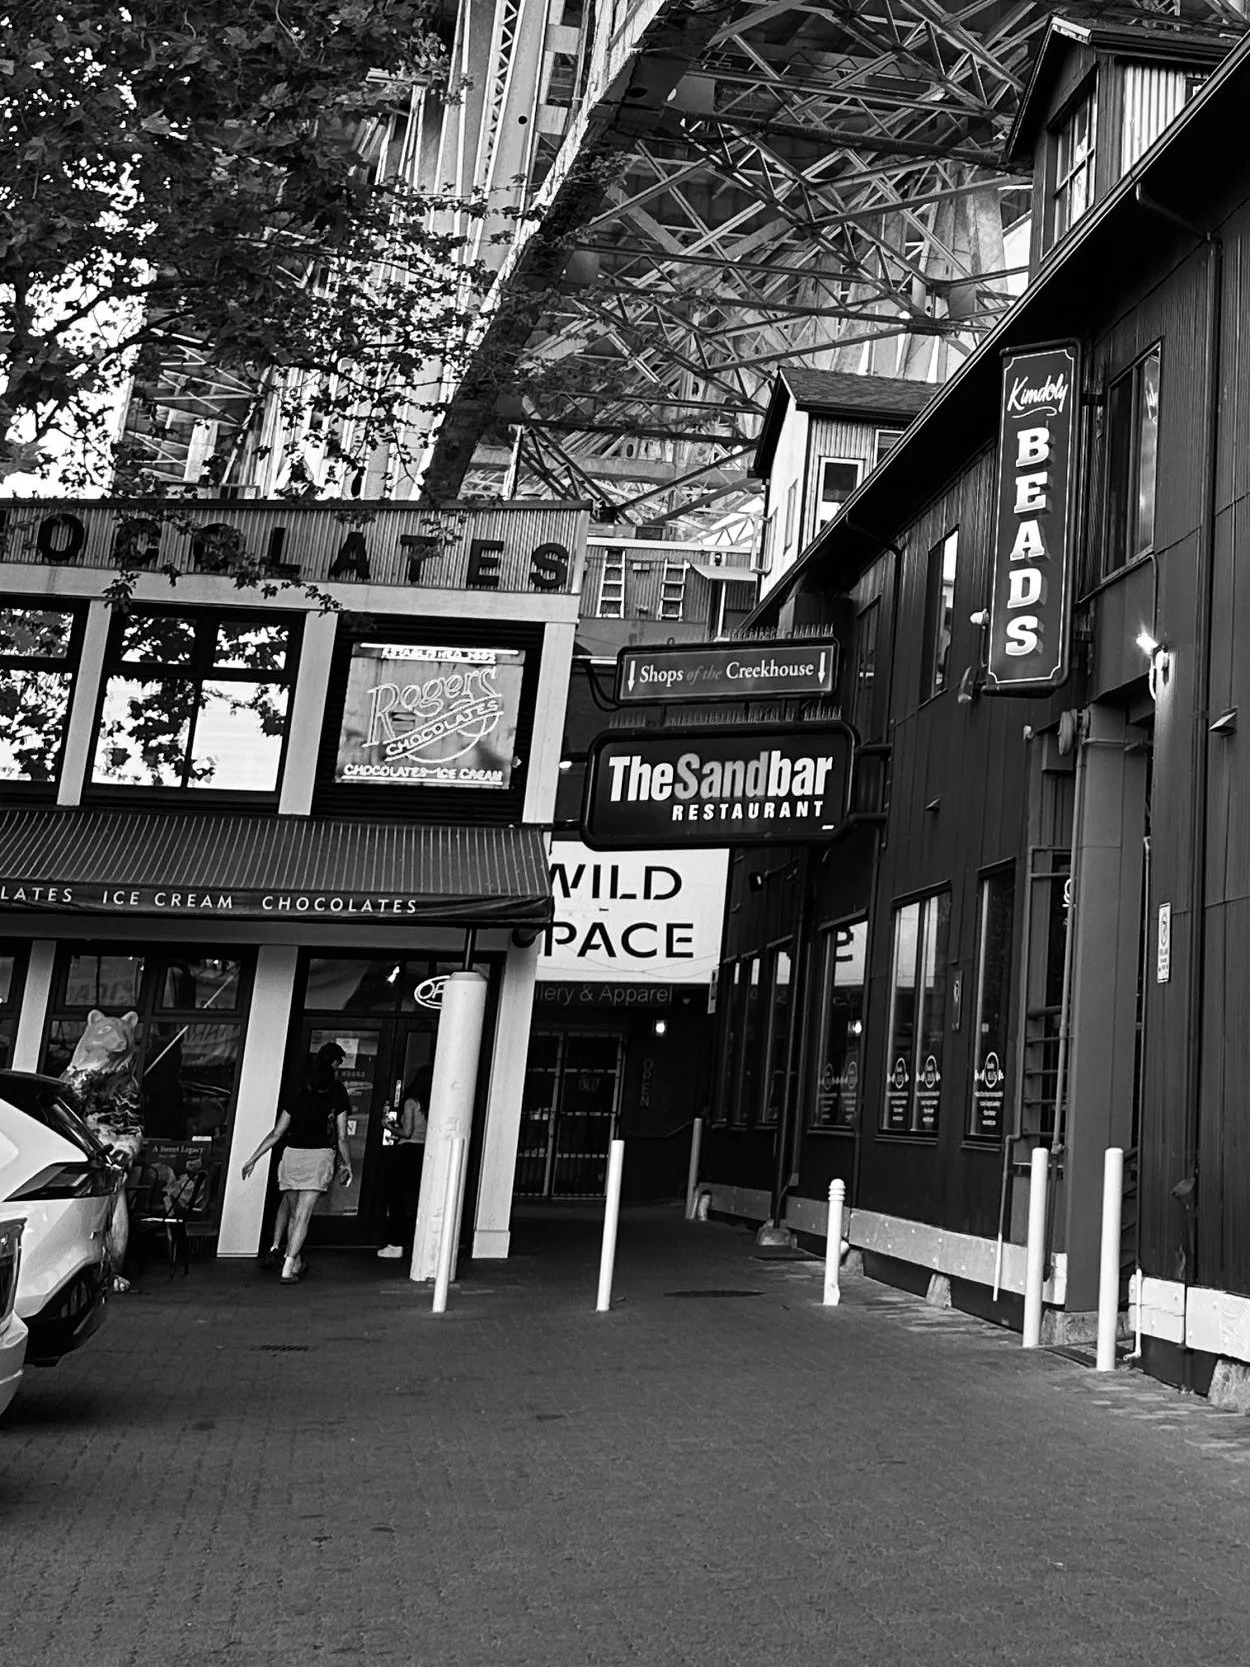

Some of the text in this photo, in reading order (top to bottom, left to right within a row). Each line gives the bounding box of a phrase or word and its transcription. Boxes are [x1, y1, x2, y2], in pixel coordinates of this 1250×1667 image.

[1007, 373, 1069, 413] Kimdoly
[0, 511, 569, 590] OCOLATES
[1005, 426, 1052, 657] BEADS
[639, 659, 814, 687] Shops of the Creekhouse
[386, 700, 498, 755] CHOCOLATES
[672, 800, 824, 821] RESTAURANT
[0, 886, 417, 914] LATES ICE CREAM CHOCOLATES
[544, 921, 694, 959] PACE
[579, 984, 594, 1002] &
[600, 984, 673, 1007] Apparel
